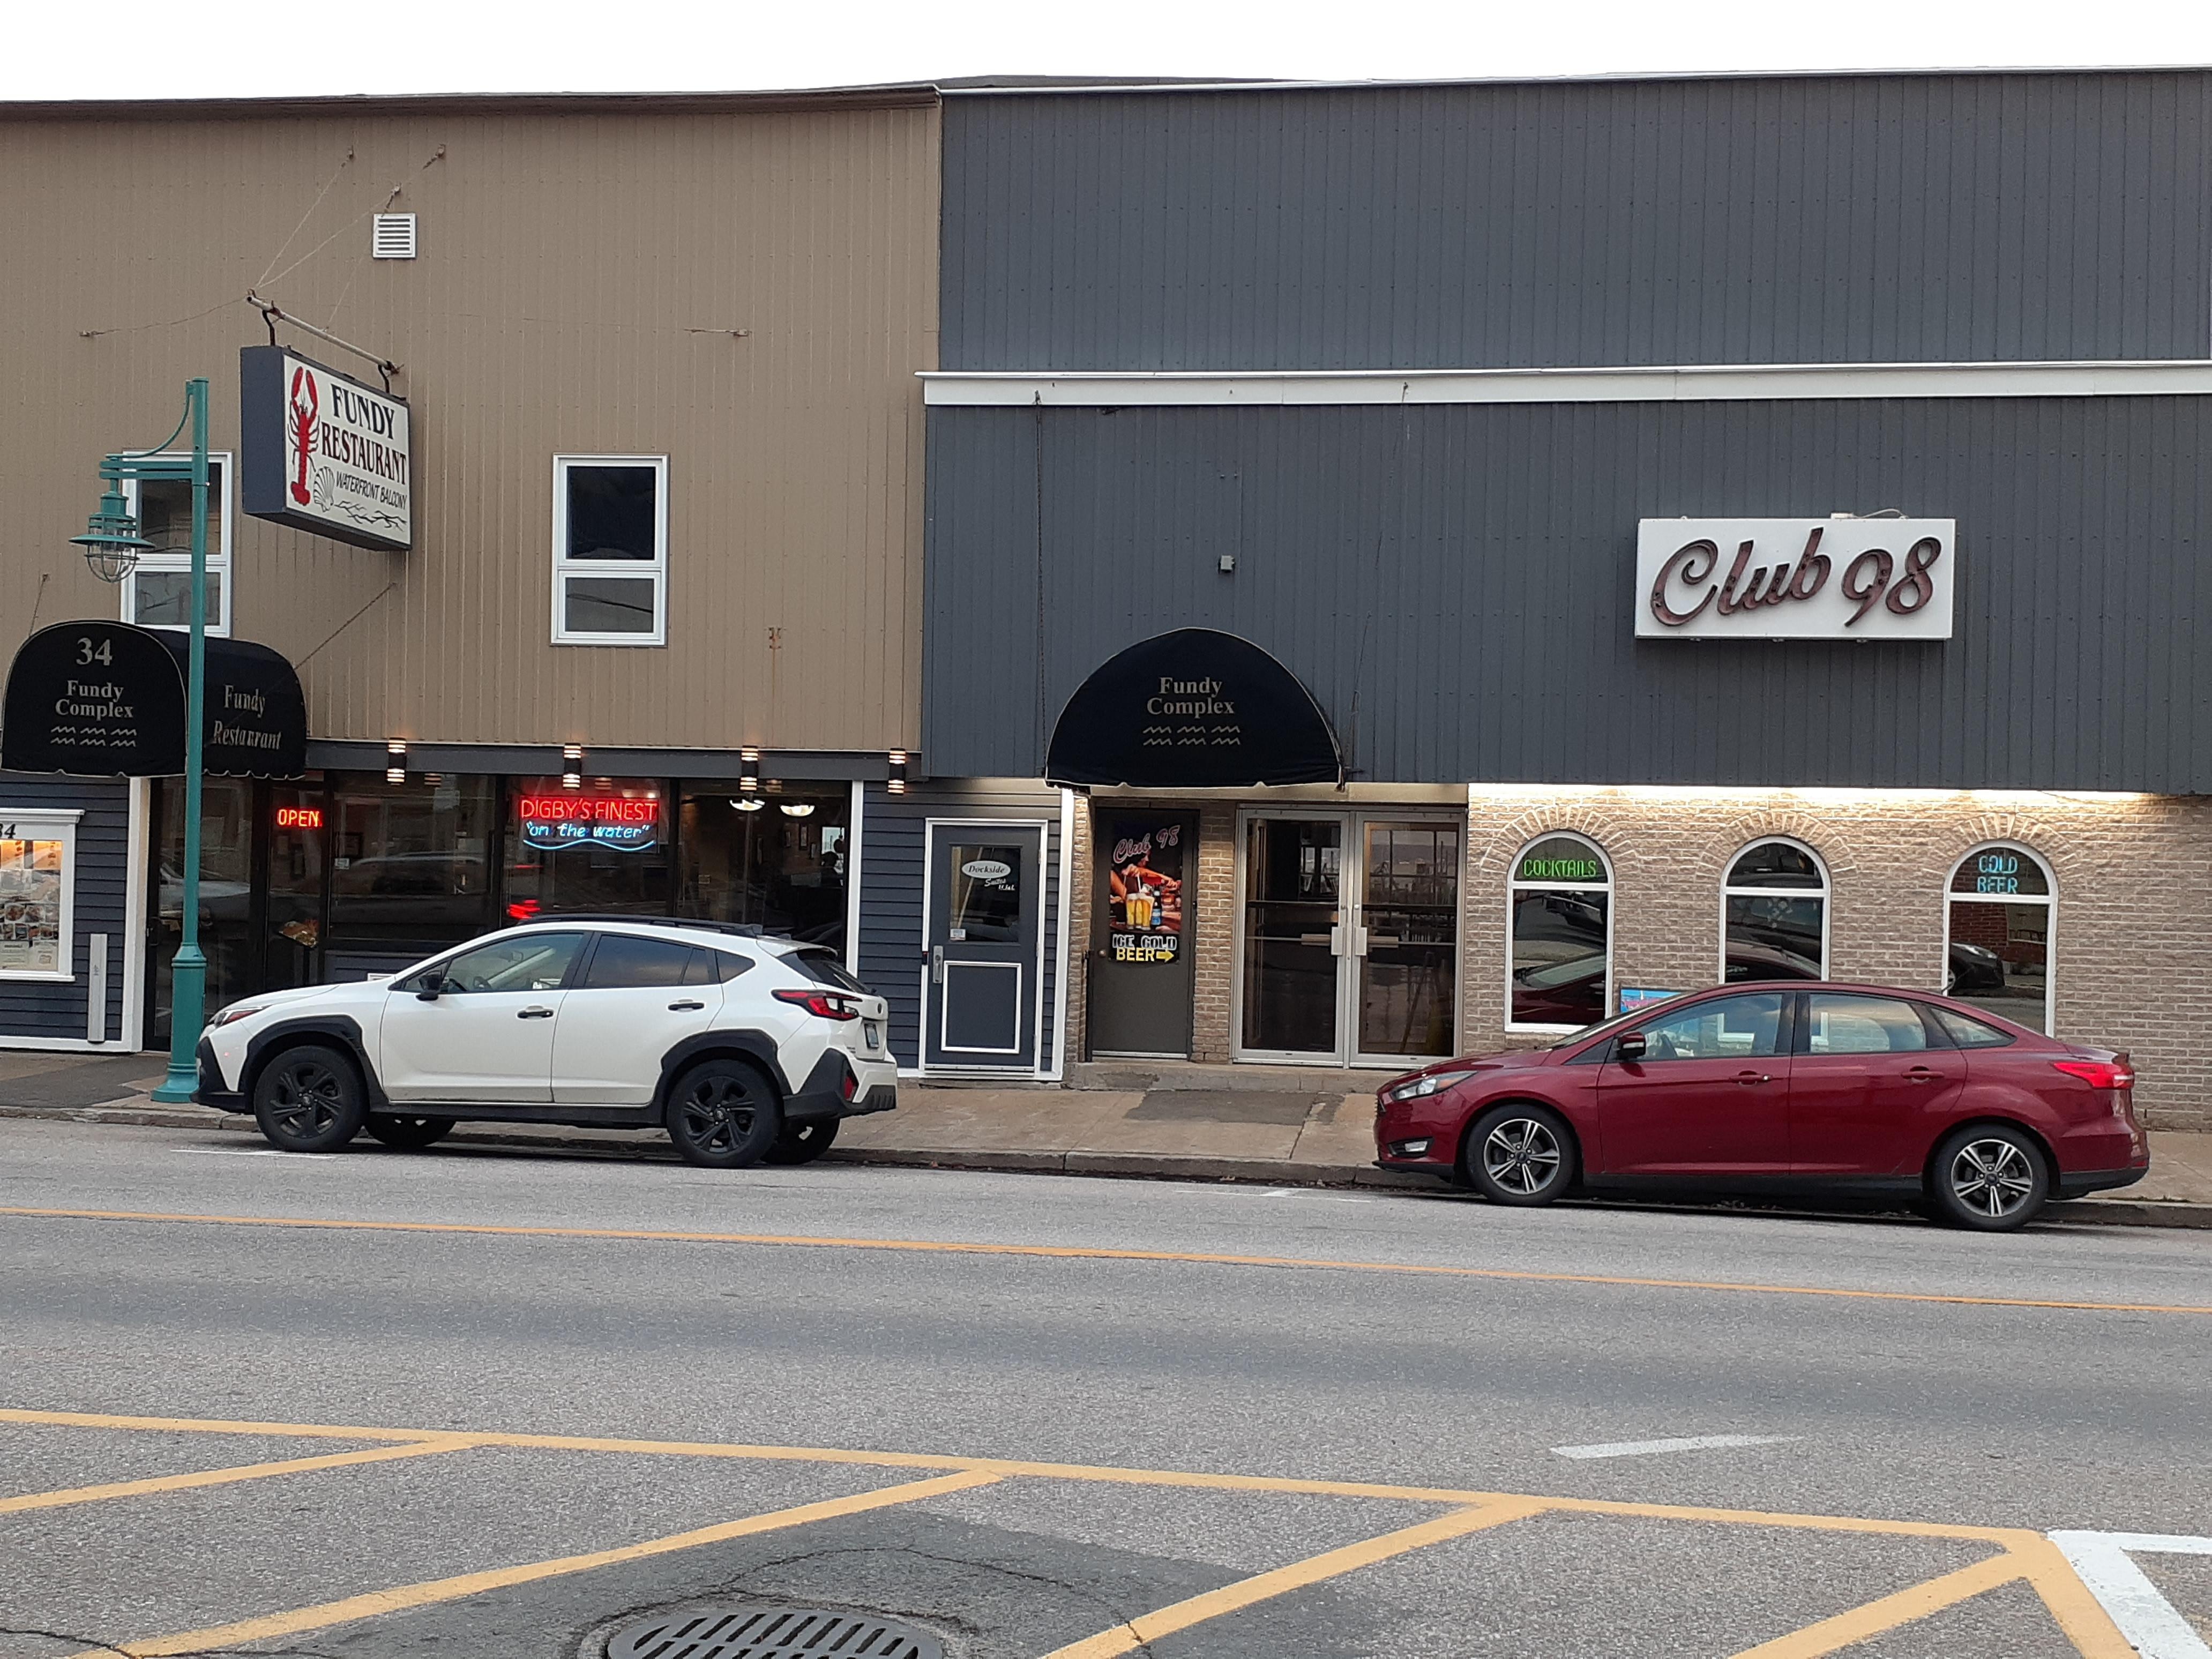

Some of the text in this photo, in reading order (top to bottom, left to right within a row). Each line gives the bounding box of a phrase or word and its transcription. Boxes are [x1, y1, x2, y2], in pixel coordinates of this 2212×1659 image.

[331, 384, 394, 439] FUNDY
[322, 422, 406, 485] RESTAURANT
[336, 471, 407, 510] WATERFRONT BALCONY
[1650, 526, 1942, 627] Club 98
[76, 637, 113, 666] 34
[67, 680, 124, 703] Fundy
[1159, 677, 1223, 698] Fundy
[55, 699, 133, 721] Complex
[223, 685, 266, 718] Fundy
[1147, 698, 1235, 719] Complex
[213, 721, 282, 750] Restaurant
[278, 808, 320, 827] OPEN
[521, 798, 658, 821] DIGBY'S FINEST
[557, 823, 585, 837] the
[1113, 825, 1180, 864] Club 98
[968, 865, 1005, 873] Dockside
[1523, 859, 1597, 878] COCKTAILS
[1978, 855, 2019, 875] COLD
[1977, 876, 2019, 894] BEER
[1112, 934, 1177, 951] ICE COLD
[1116, 947, 1155, 962] BEER
